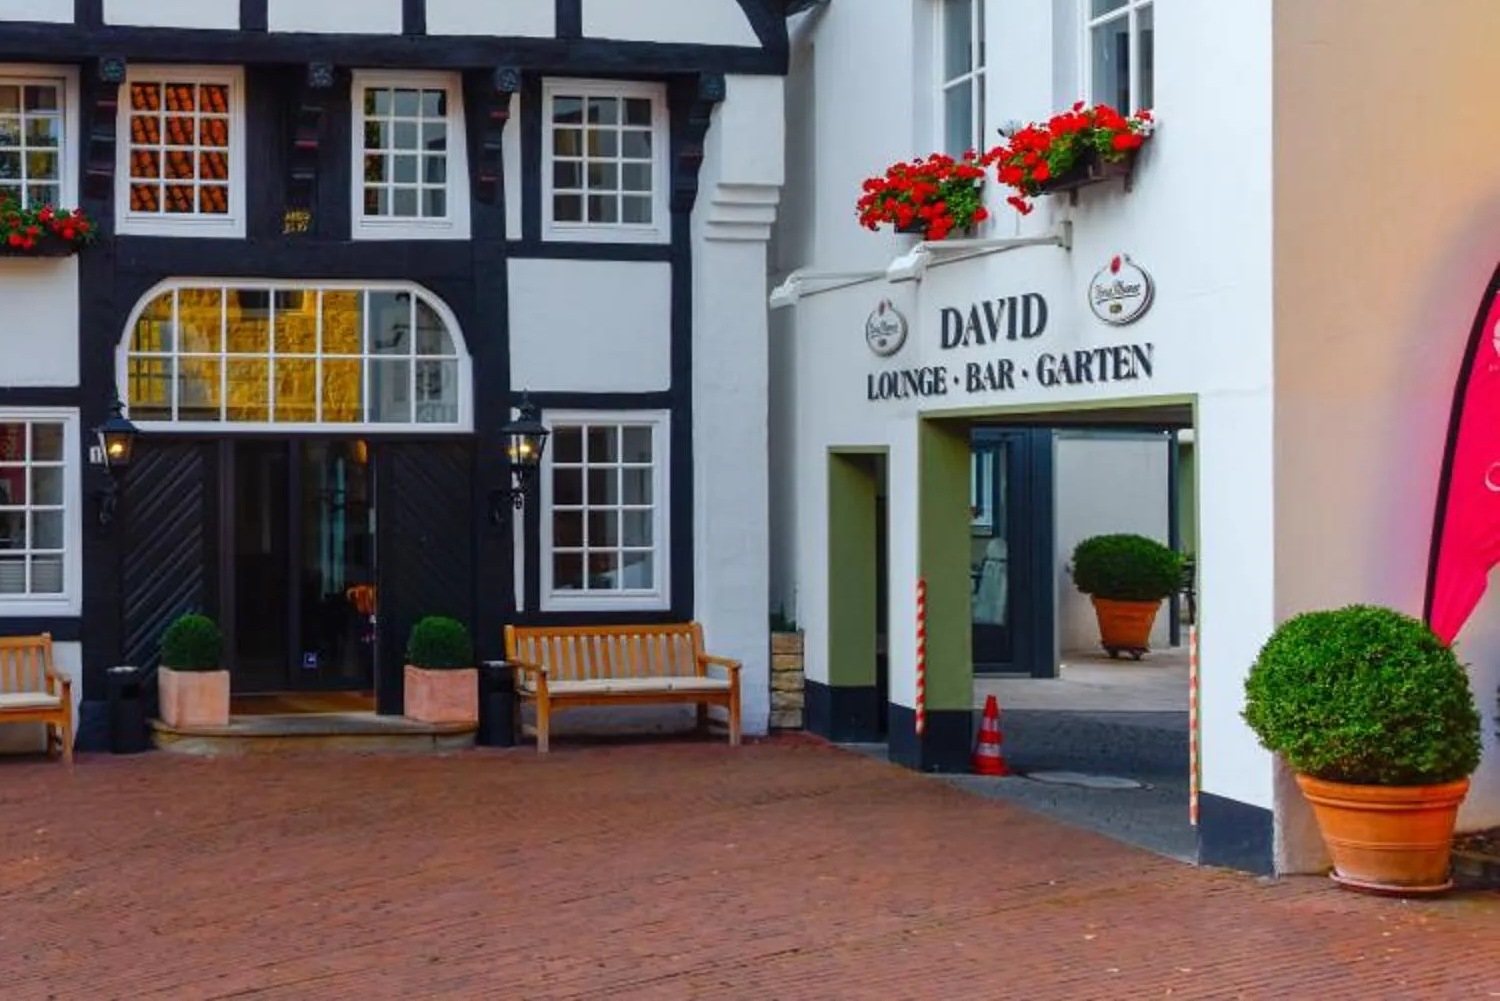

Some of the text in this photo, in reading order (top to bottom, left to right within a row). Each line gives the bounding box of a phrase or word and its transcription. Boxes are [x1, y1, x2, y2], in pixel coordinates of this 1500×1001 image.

[940, 292, 1048, 350] DAVID
[867, 342, 1154, 400] LOUNGE BAR GARTEN
